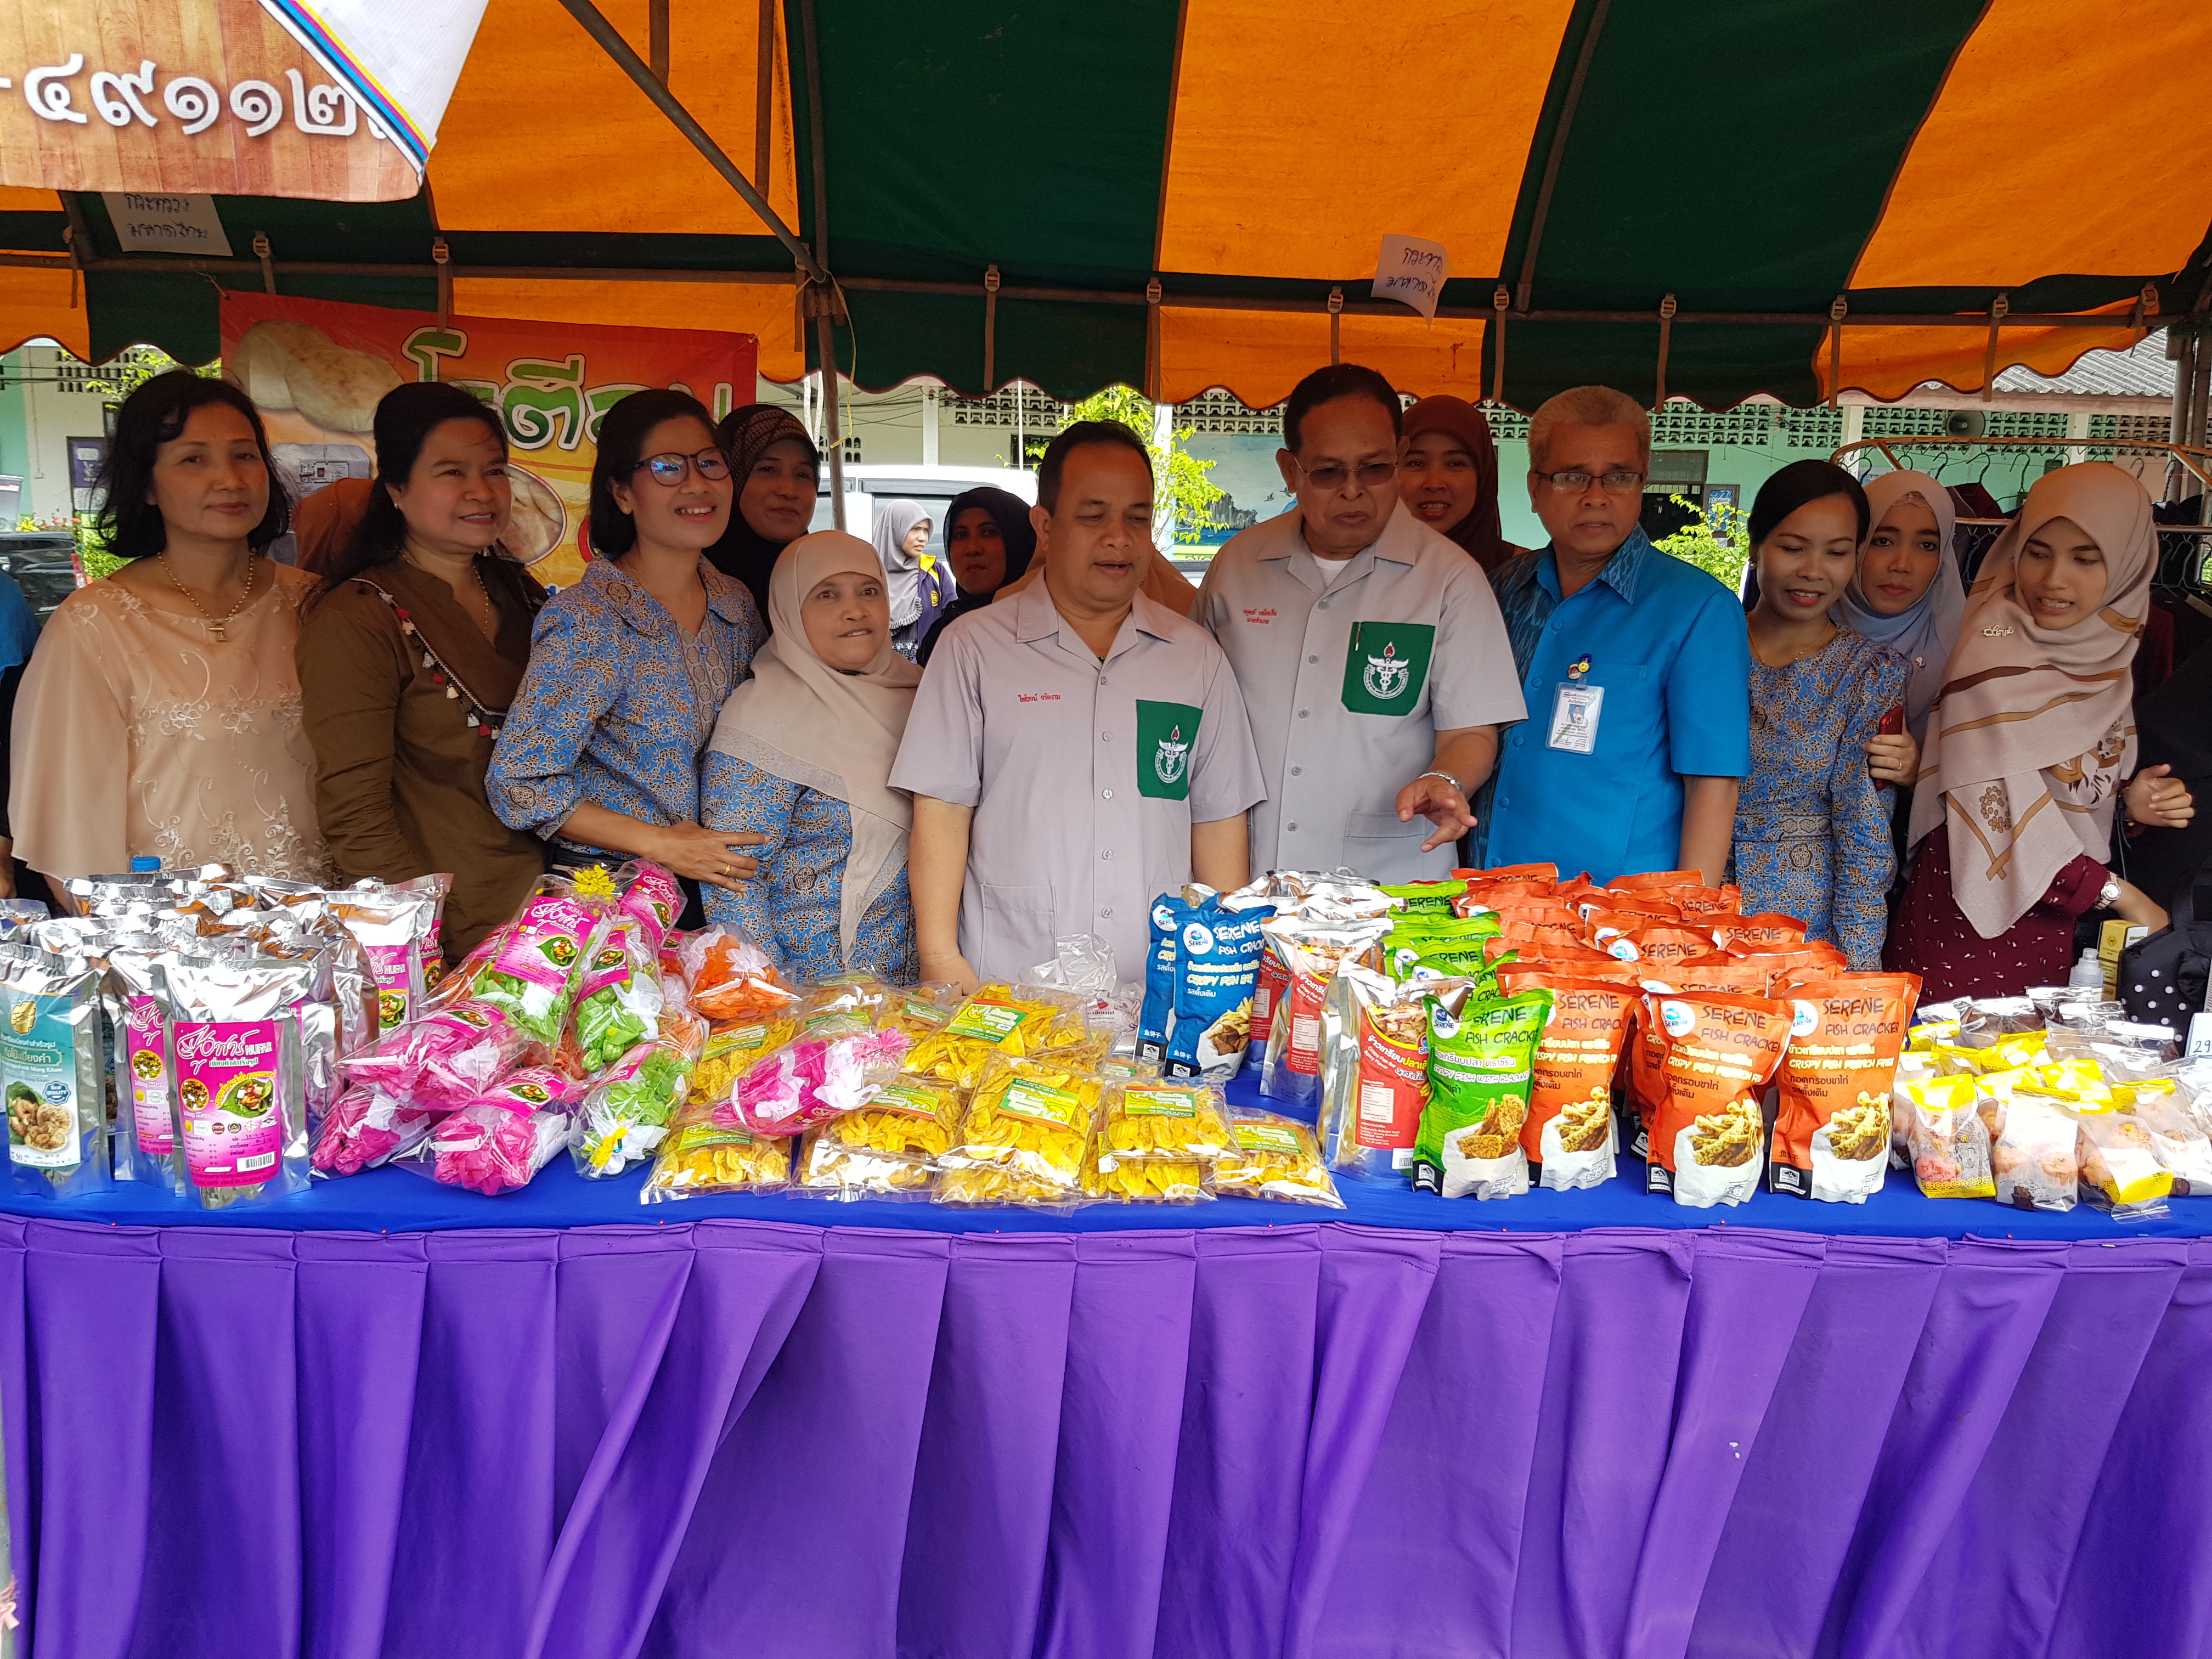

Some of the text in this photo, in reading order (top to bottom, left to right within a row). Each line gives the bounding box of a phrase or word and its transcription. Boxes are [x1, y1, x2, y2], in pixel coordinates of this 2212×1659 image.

[1681, 900, 1729, 913] SERENE
[1213, 920, 1261, 942] SERENE
[1725, 927, 1781, 940] SERENE
[1218, 945, 1238, 955] FISH
[1640, 943, 1697, 959] SERENE
[1187, 973, 1254, 986] CRISPY FISH BAR
[1559, 994, 1620, 1012] SERENE
[1822, 997, 1884, 1017] SERENE
[1562, 1018, 1587, 1030] FISH
[1701, 1005, 1767, 1030] SERENE
[1434, 1020, 1454, 1029] SERENE
[1825, 1022, 1899, 1036] FISH CRACKER
[1465, 1031, 1488, 1045] FISH
[1701, 1028, 1729, 1041] FISH
[245, 1041, 273, 1056] NUFAR
[2193, 1040, 2212, 1053] 29
[1485, 1056, 1516, 1069] ตราซีรีน
[1556, 1053, 1578, 1064] FISH
[1578, 1053, 1610, 1065] FRENCH
[1788, 1058, 1822, 1070] CRISPY
[1821, 1059, 1844, 1070] FISH
[1843, 1058, 1875, 1070] FRENCH
[1667, 1056, 1693, 1070] CRISPY
[1692, 1062, 1716, 1074] FISH
[1714, 1065, 1751, 1081] FRENCH
[1454, 1073, 1476, 1082] FISH
[1476, 1073, 1499, 1084] WITH
[1499, 1073, 1522, 1084] BLACK
[1790, 1074, 1849, 1085] ทอดกรอบขาไก่
